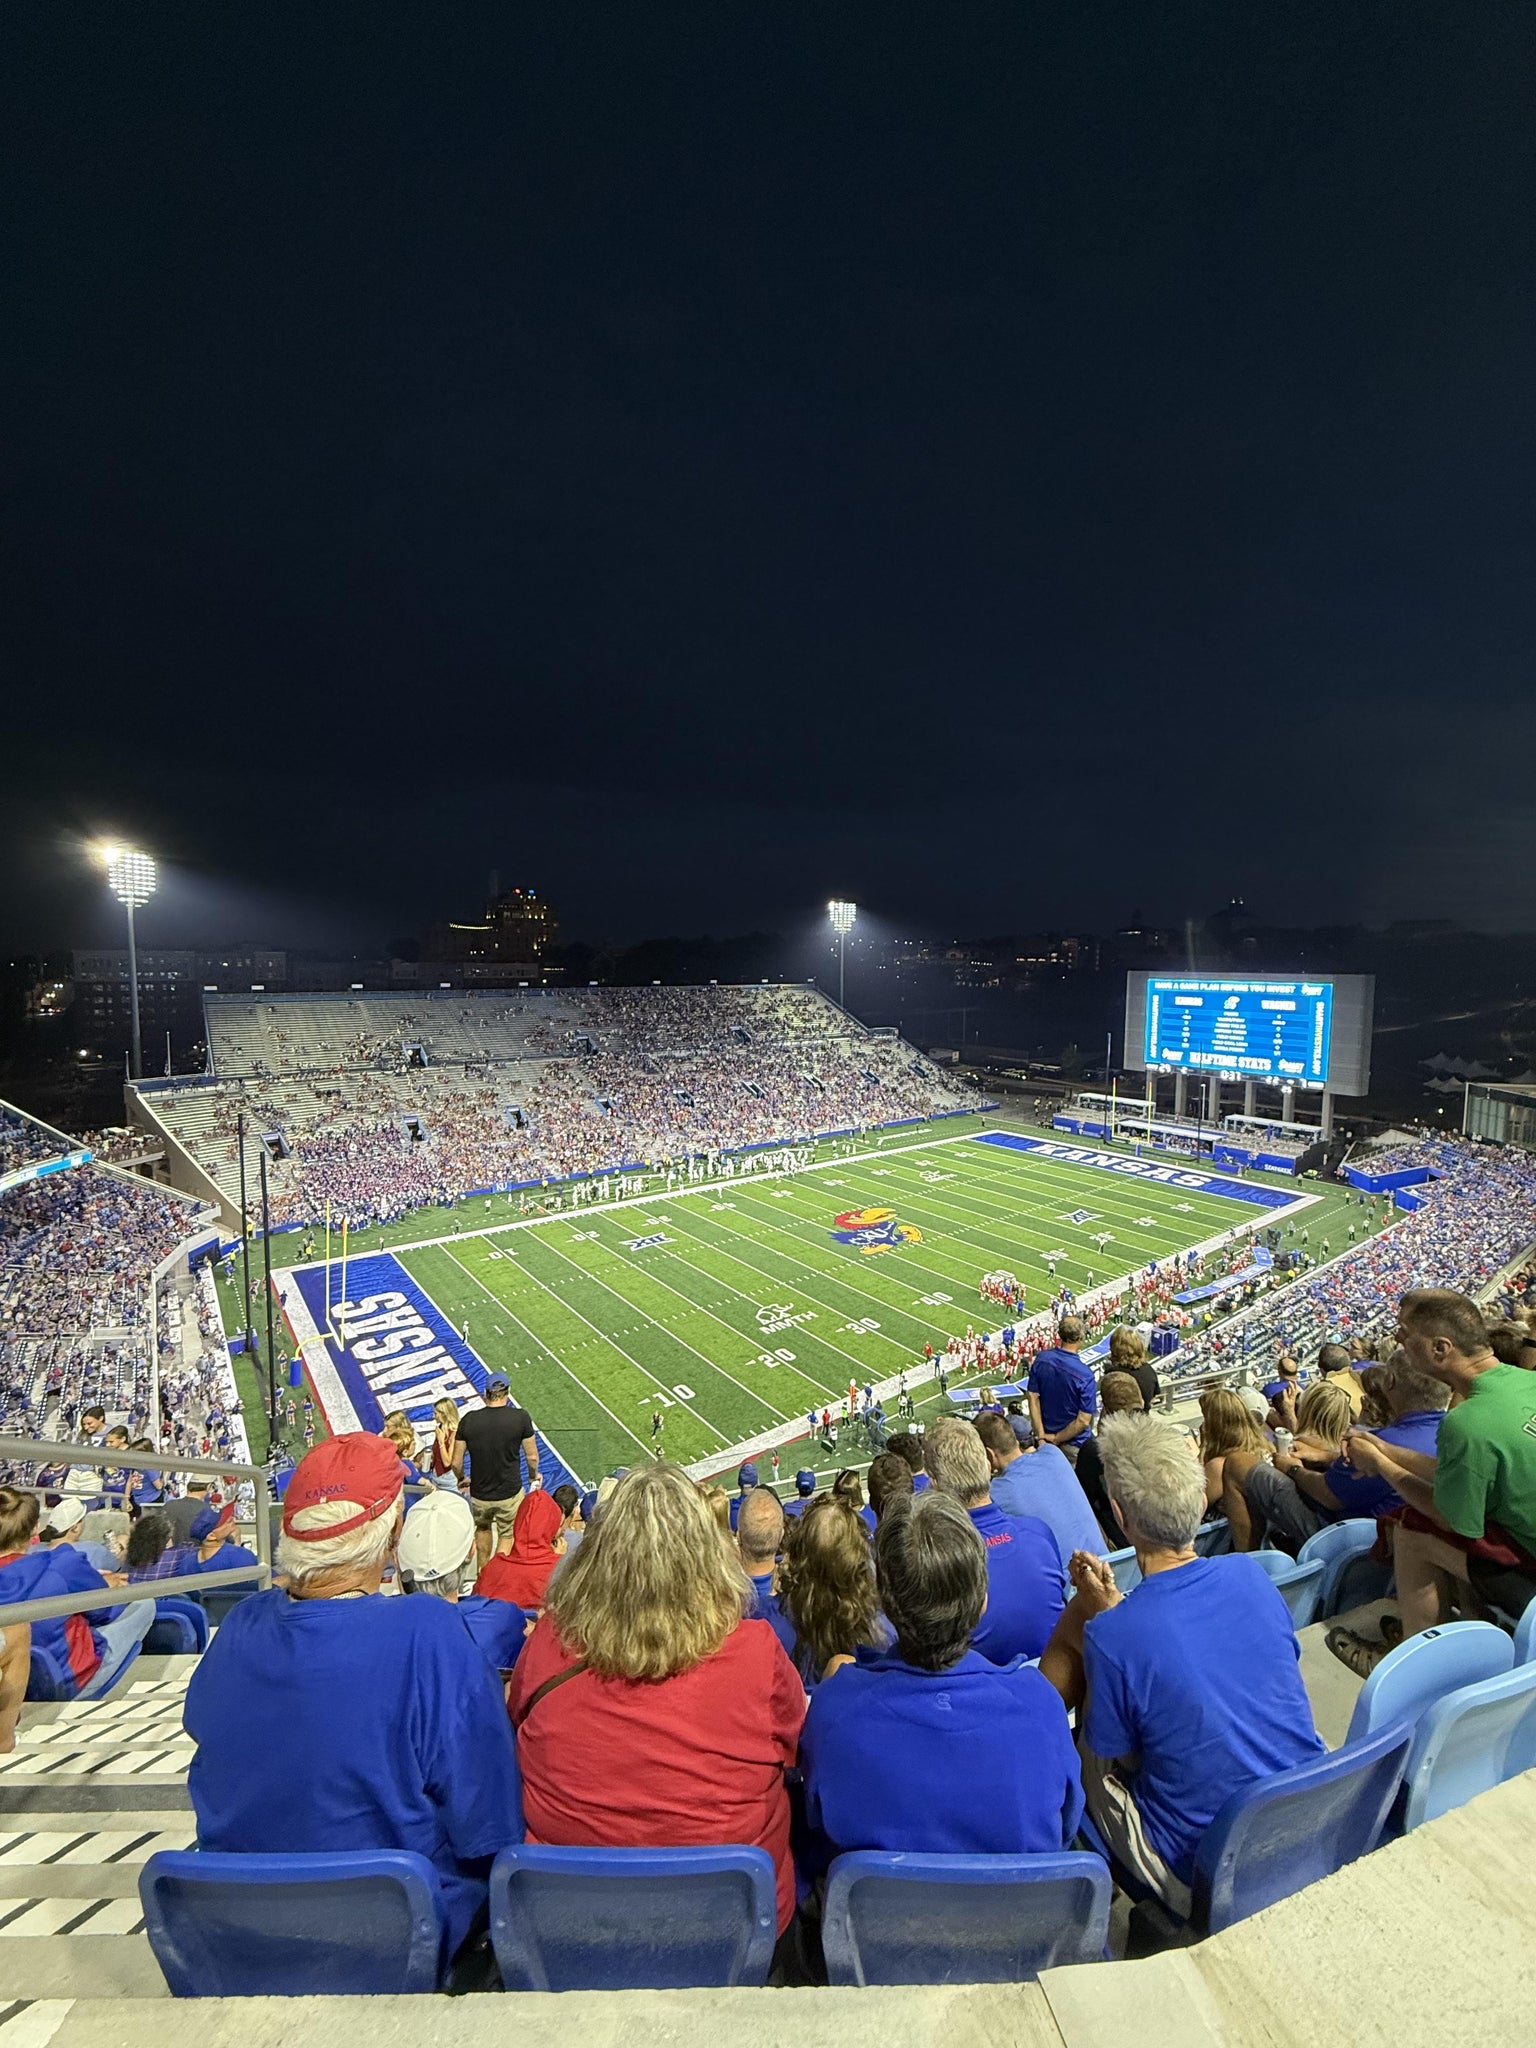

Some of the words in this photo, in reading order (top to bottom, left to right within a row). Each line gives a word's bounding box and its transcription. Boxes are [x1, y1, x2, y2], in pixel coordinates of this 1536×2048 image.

[1200, 983, 1220, 991] PLAN
[1249, 985, 1266, 993] YOU
[1238, 1056, 1272, 1071] STATS
[1026, 1142, 1213, 1187] KANSAS
[919, 1291, 954, 1307] 40
[758, 1310, 819, 1335] MMTH
[844, 1317, 882, 1335] 30
[757, 1348, 797, 1369] 20
[652, 1384, 696, 1408] 10
[305, 1483, 346, 1499] KANSAS
[986, 1532, 1013, 1547] ANSAS
